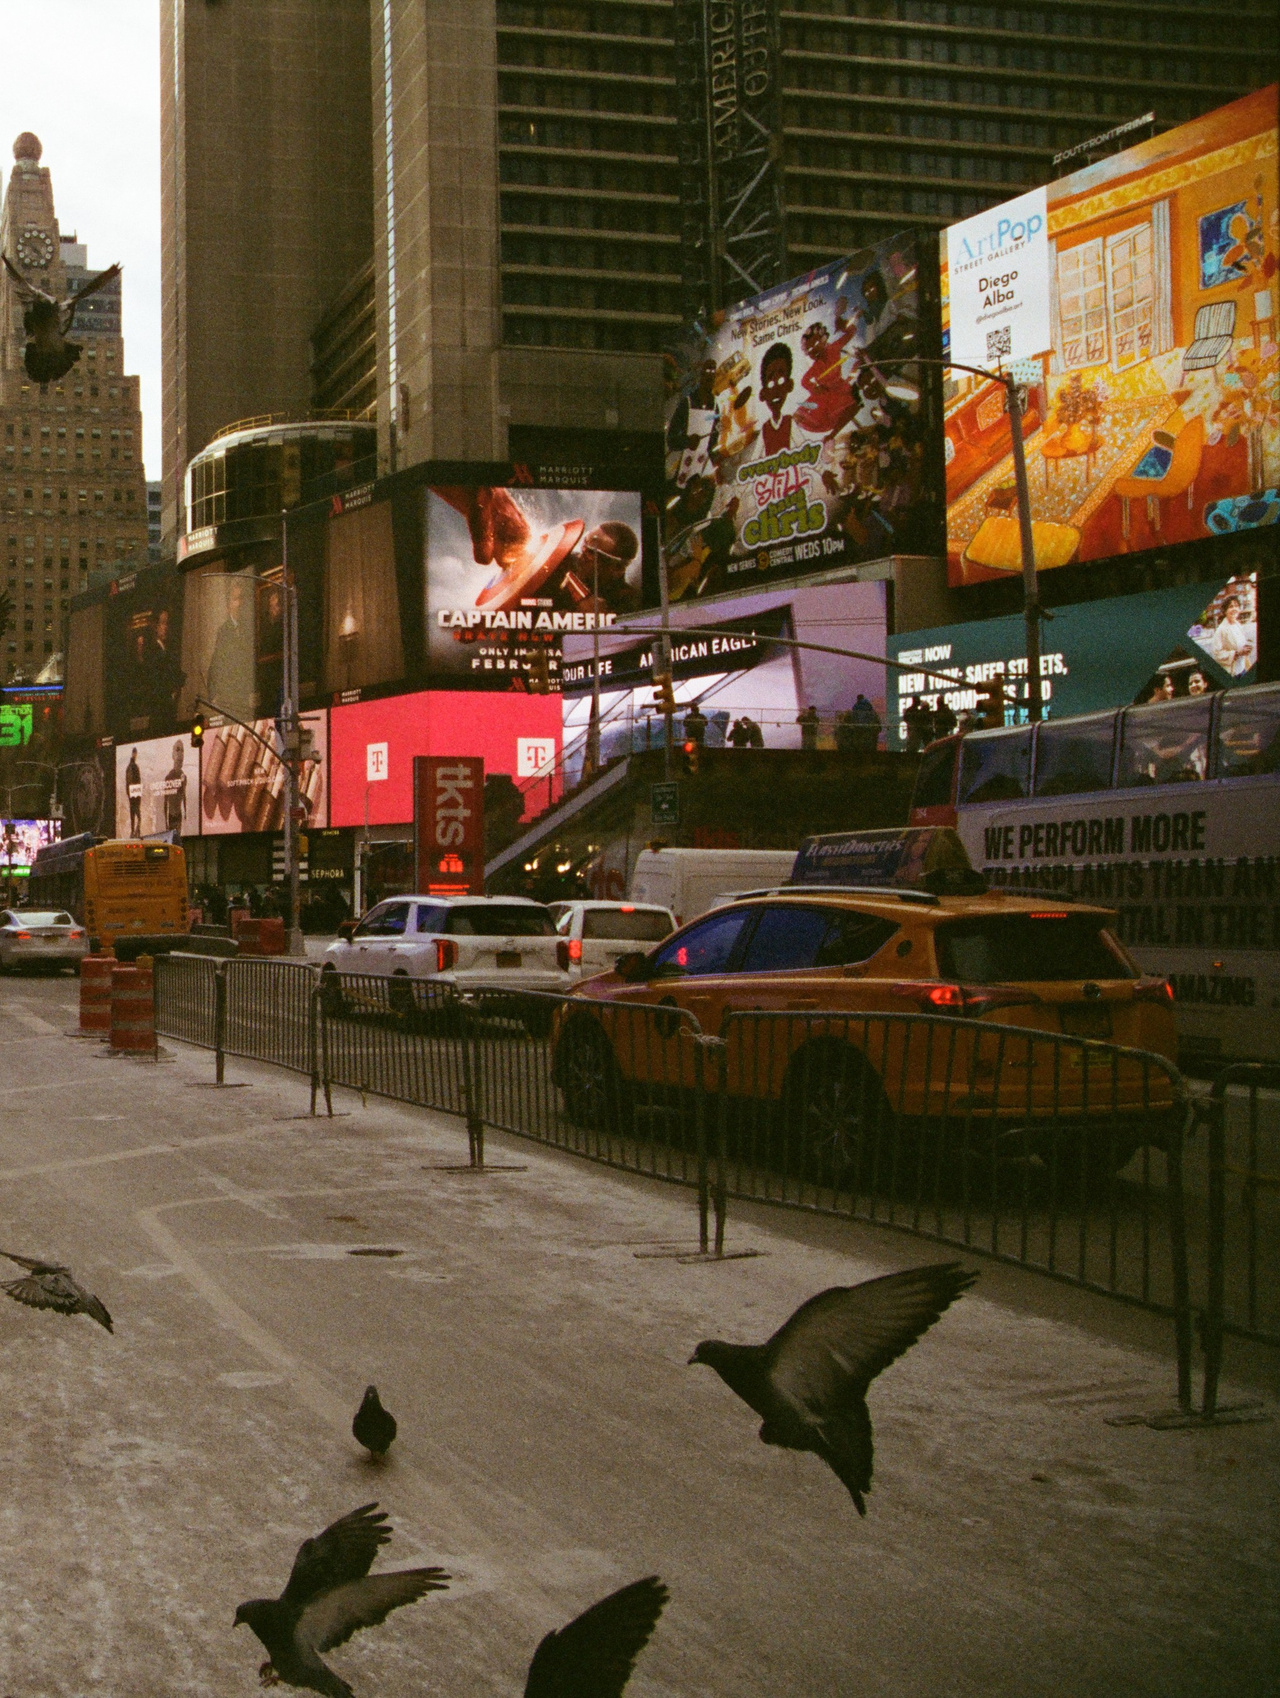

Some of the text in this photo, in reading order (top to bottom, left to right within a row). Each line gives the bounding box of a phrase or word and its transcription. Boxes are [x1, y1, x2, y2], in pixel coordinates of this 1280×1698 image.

[710, 0, 738, 147] AMERIC
[955, 214, 1043, 266] ArtPop
[954, 240, 1026, 275] STREET GALLERY
[978, 269, 1019, 293] Diego
[982, 289, 1015, 310] Alba
[749, 314, 781, 334] Stories.
[783, 306, 801, 320] New
[803, 294, 827, 313] Look.
[752, 320, 803, 348] Same Chris.
[539, 466, 594, 475] MARRIOTT
[539, 475, 588, 485] MARQUIS
[795, 538, 845, 561] WEDS 10PM
[437, 609, 617, 630] CAPTAIN AMERIC
[479, 647, 509, 656] ONLY
[588, 660, 613, 678] LFE
[711, 630, 757, 655] EAGL
[925, 644, 952, 662] NOW
[898, 673, 926, 695] NEW
[0, 713, 33, 747] 31
[436, 763, 474, 847] tkts
[984, 811, 1207, 860] WE PERFORM MORE
[311, 869, 345, 879] SEPHORA
[1149, 858, 1223, 897] THAN
[1176, 905, 1204, 944] IN
[1210, 905, 1267, 945] THE
